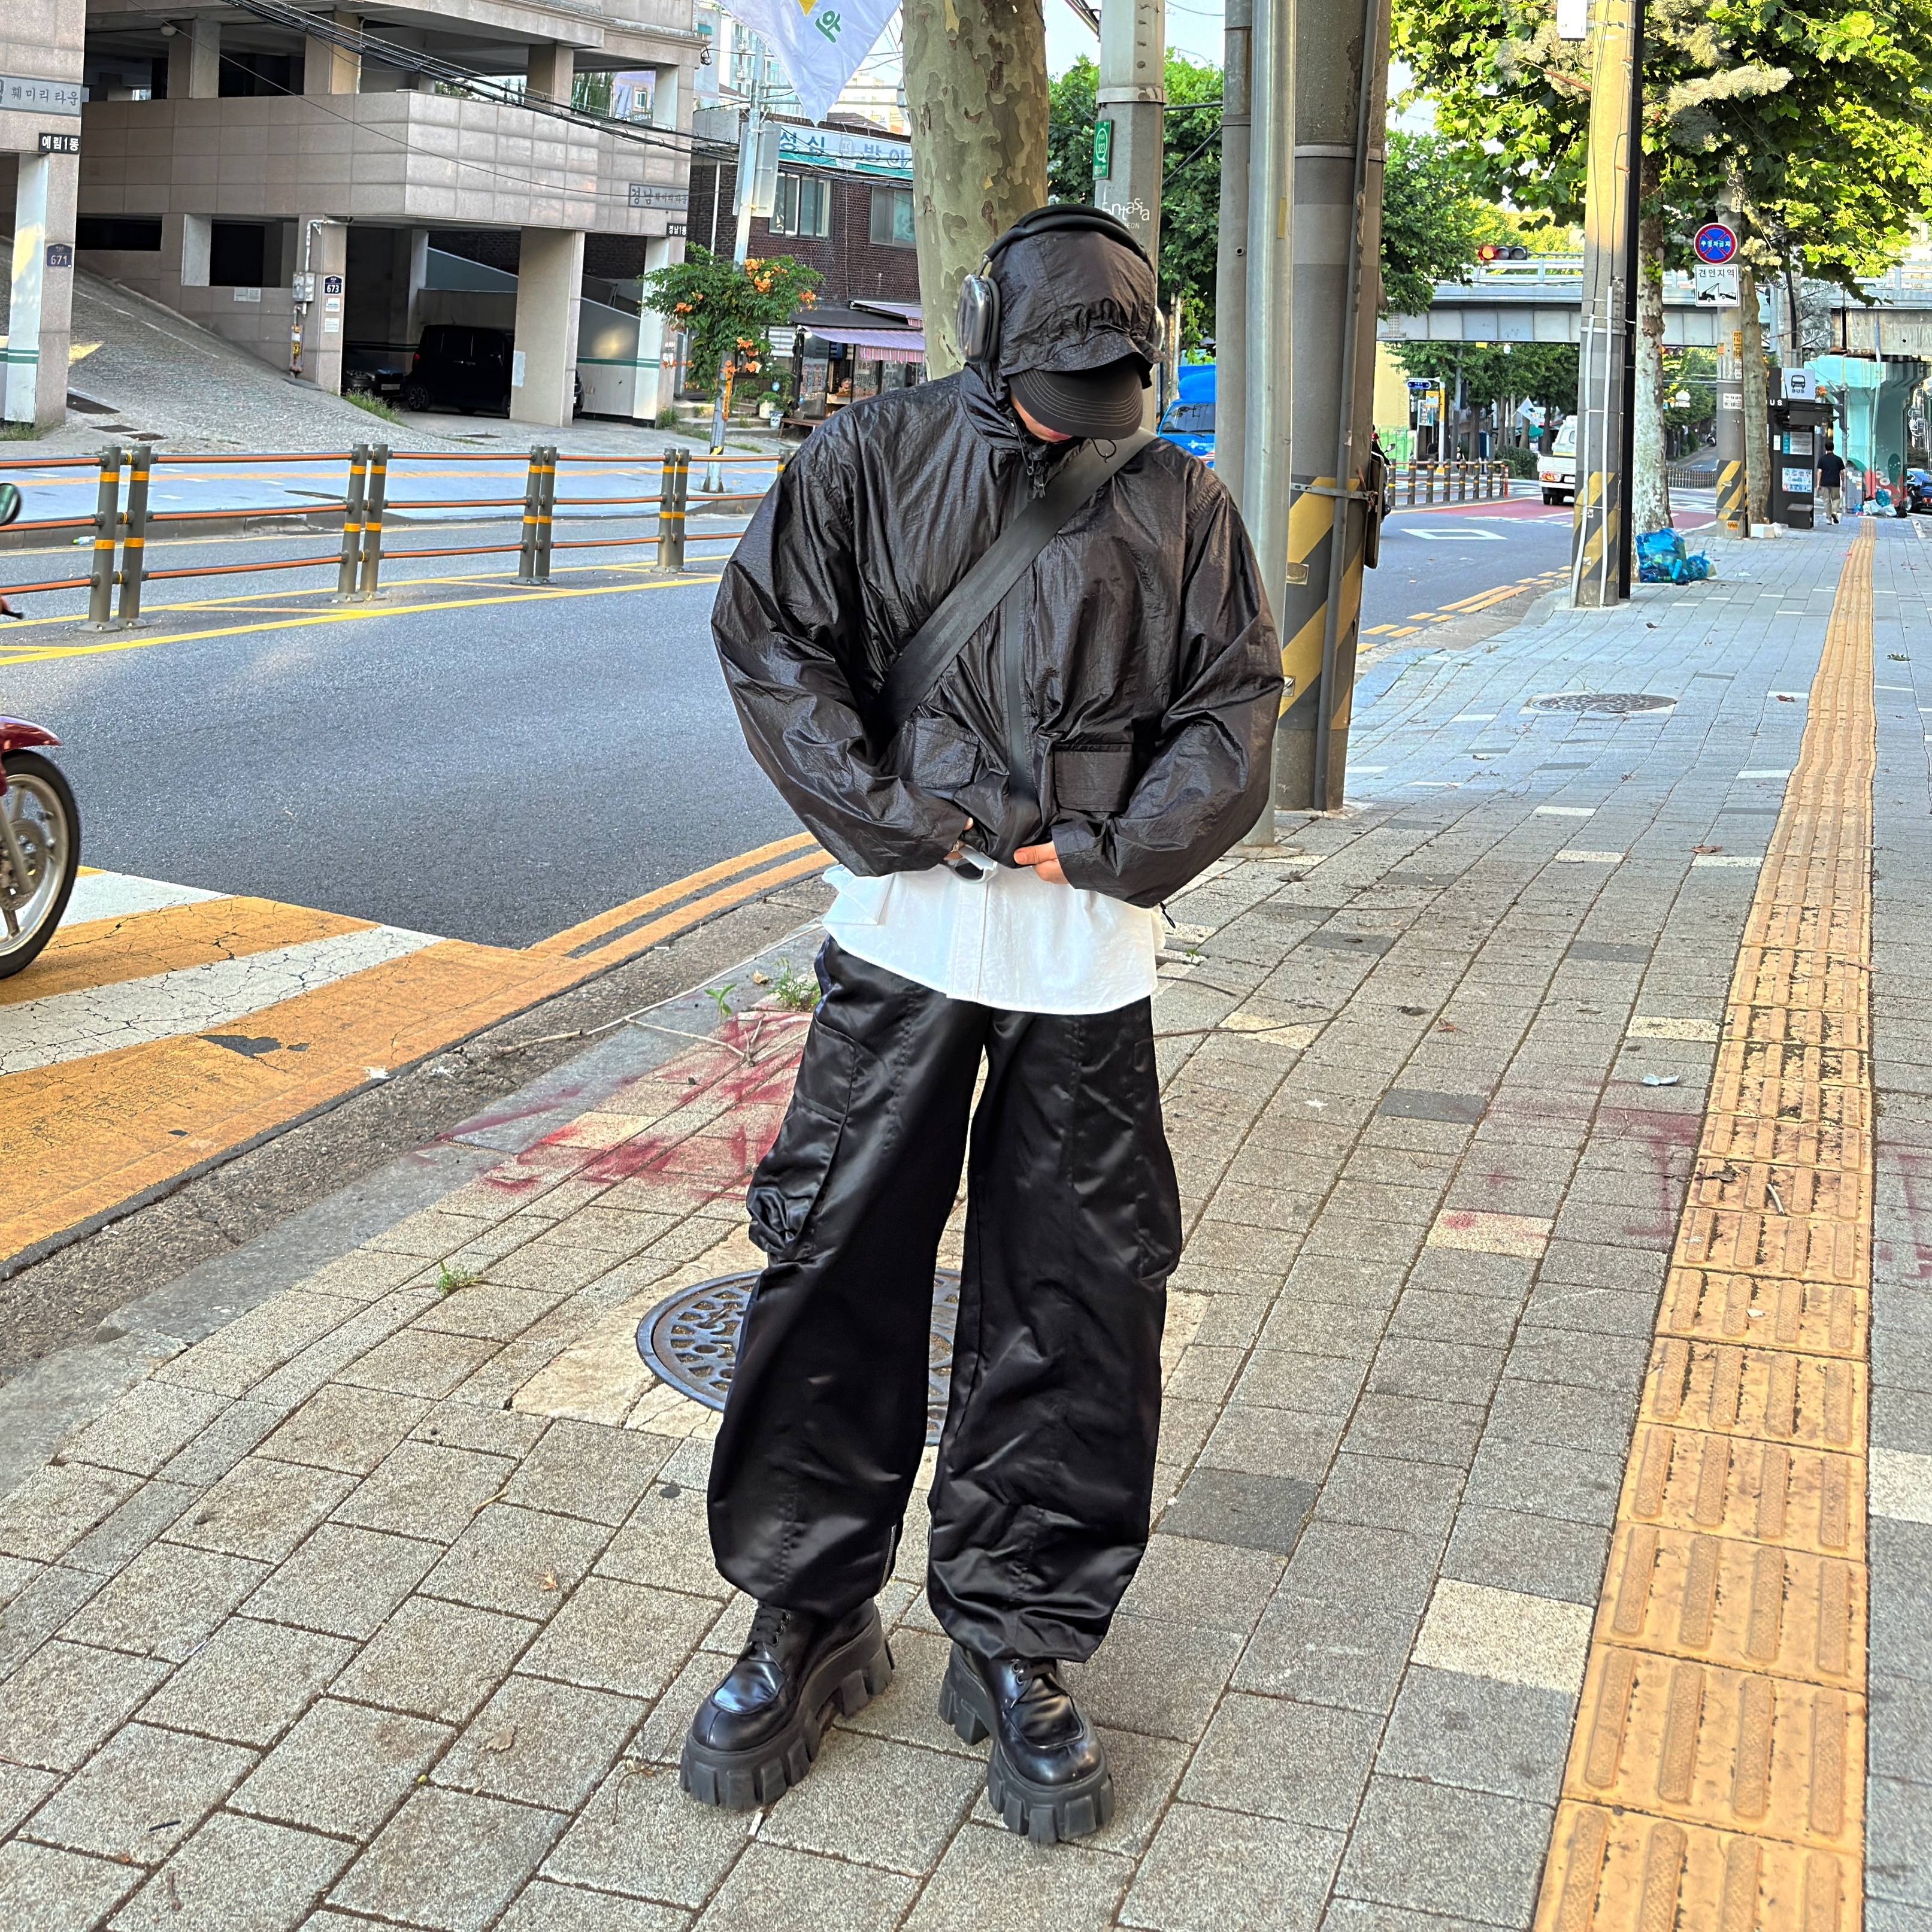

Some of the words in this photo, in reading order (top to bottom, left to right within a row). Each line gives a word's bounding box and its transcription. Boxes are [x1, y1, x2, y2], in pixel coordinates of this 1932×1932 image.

[42, 135, 79, 152] 예림1동
[51, 255, 67, 265] 671
[1698, 268, 1734, 278] 견인지역
[326, 284, 340, 293] 673
